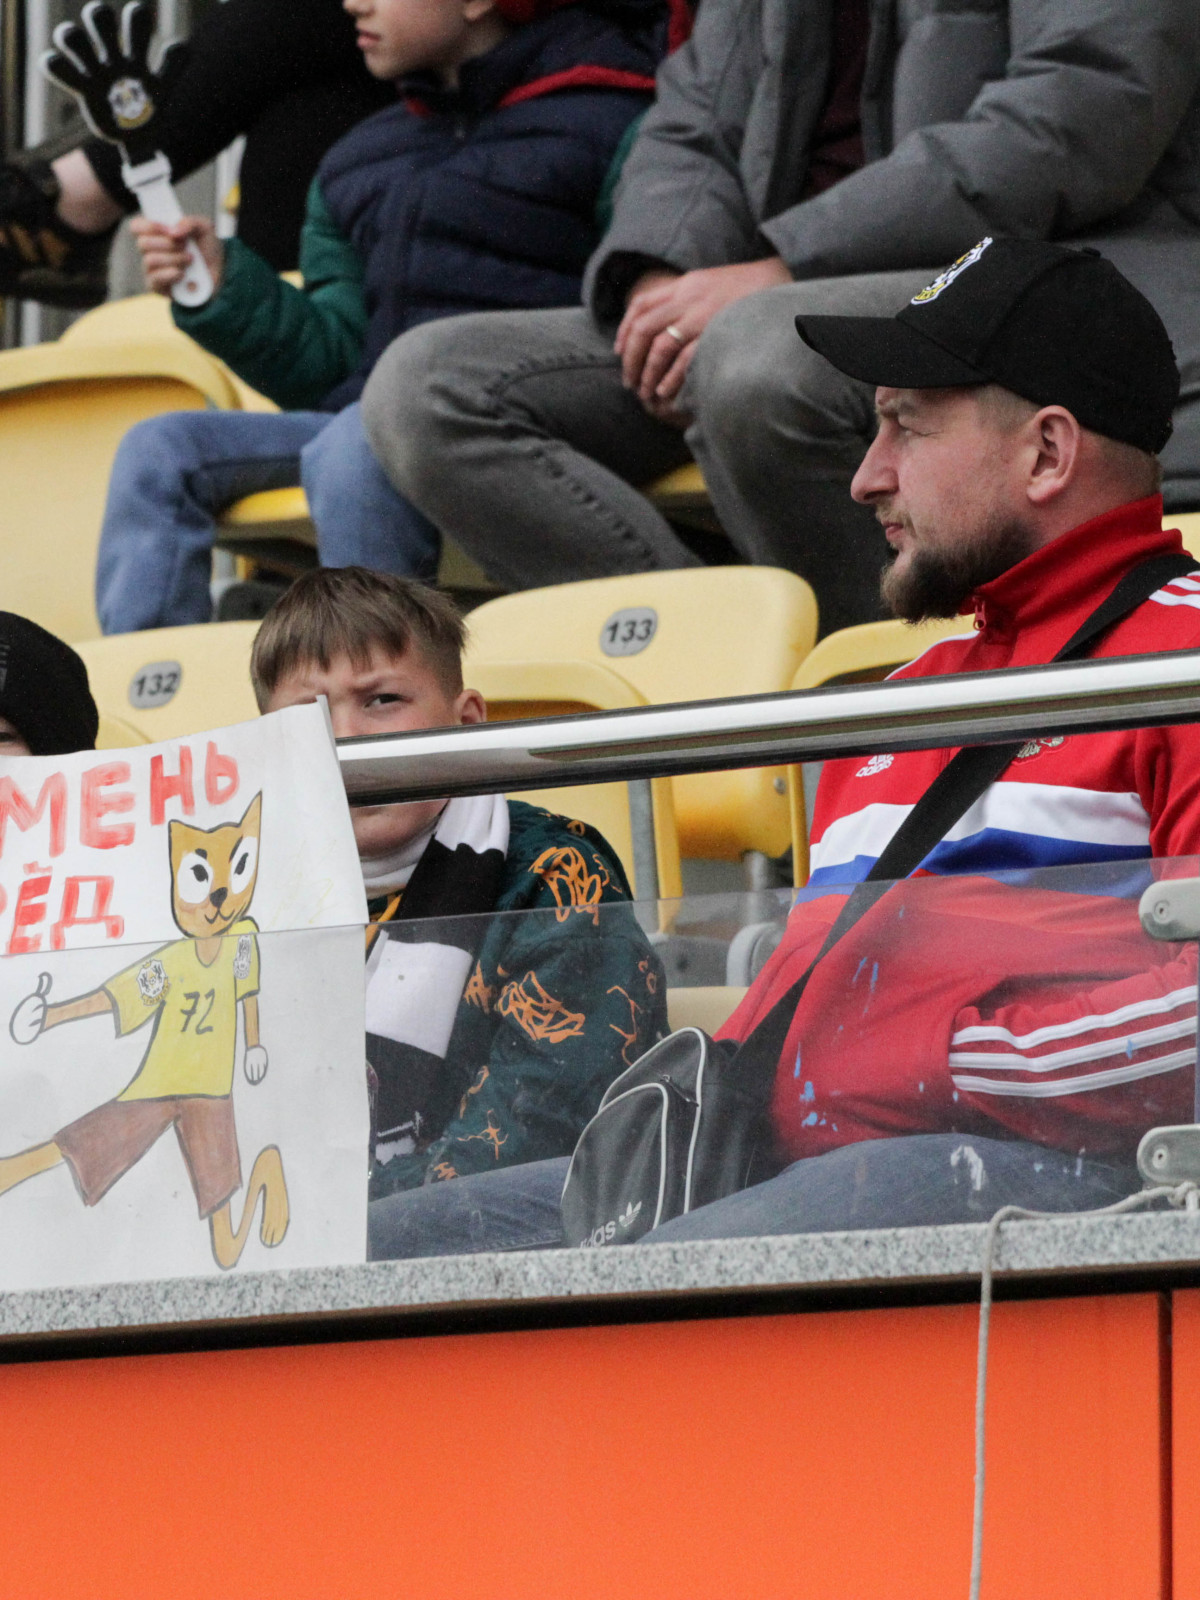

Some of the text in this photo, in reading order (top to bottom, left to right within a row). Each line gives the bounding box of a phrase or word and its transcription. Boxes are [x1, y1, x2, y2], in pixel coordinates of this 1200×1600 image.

[607, 618, 652, 643] 133
[136, 672, 178, 697] 132
[180, 988, 216, 1035] 72
